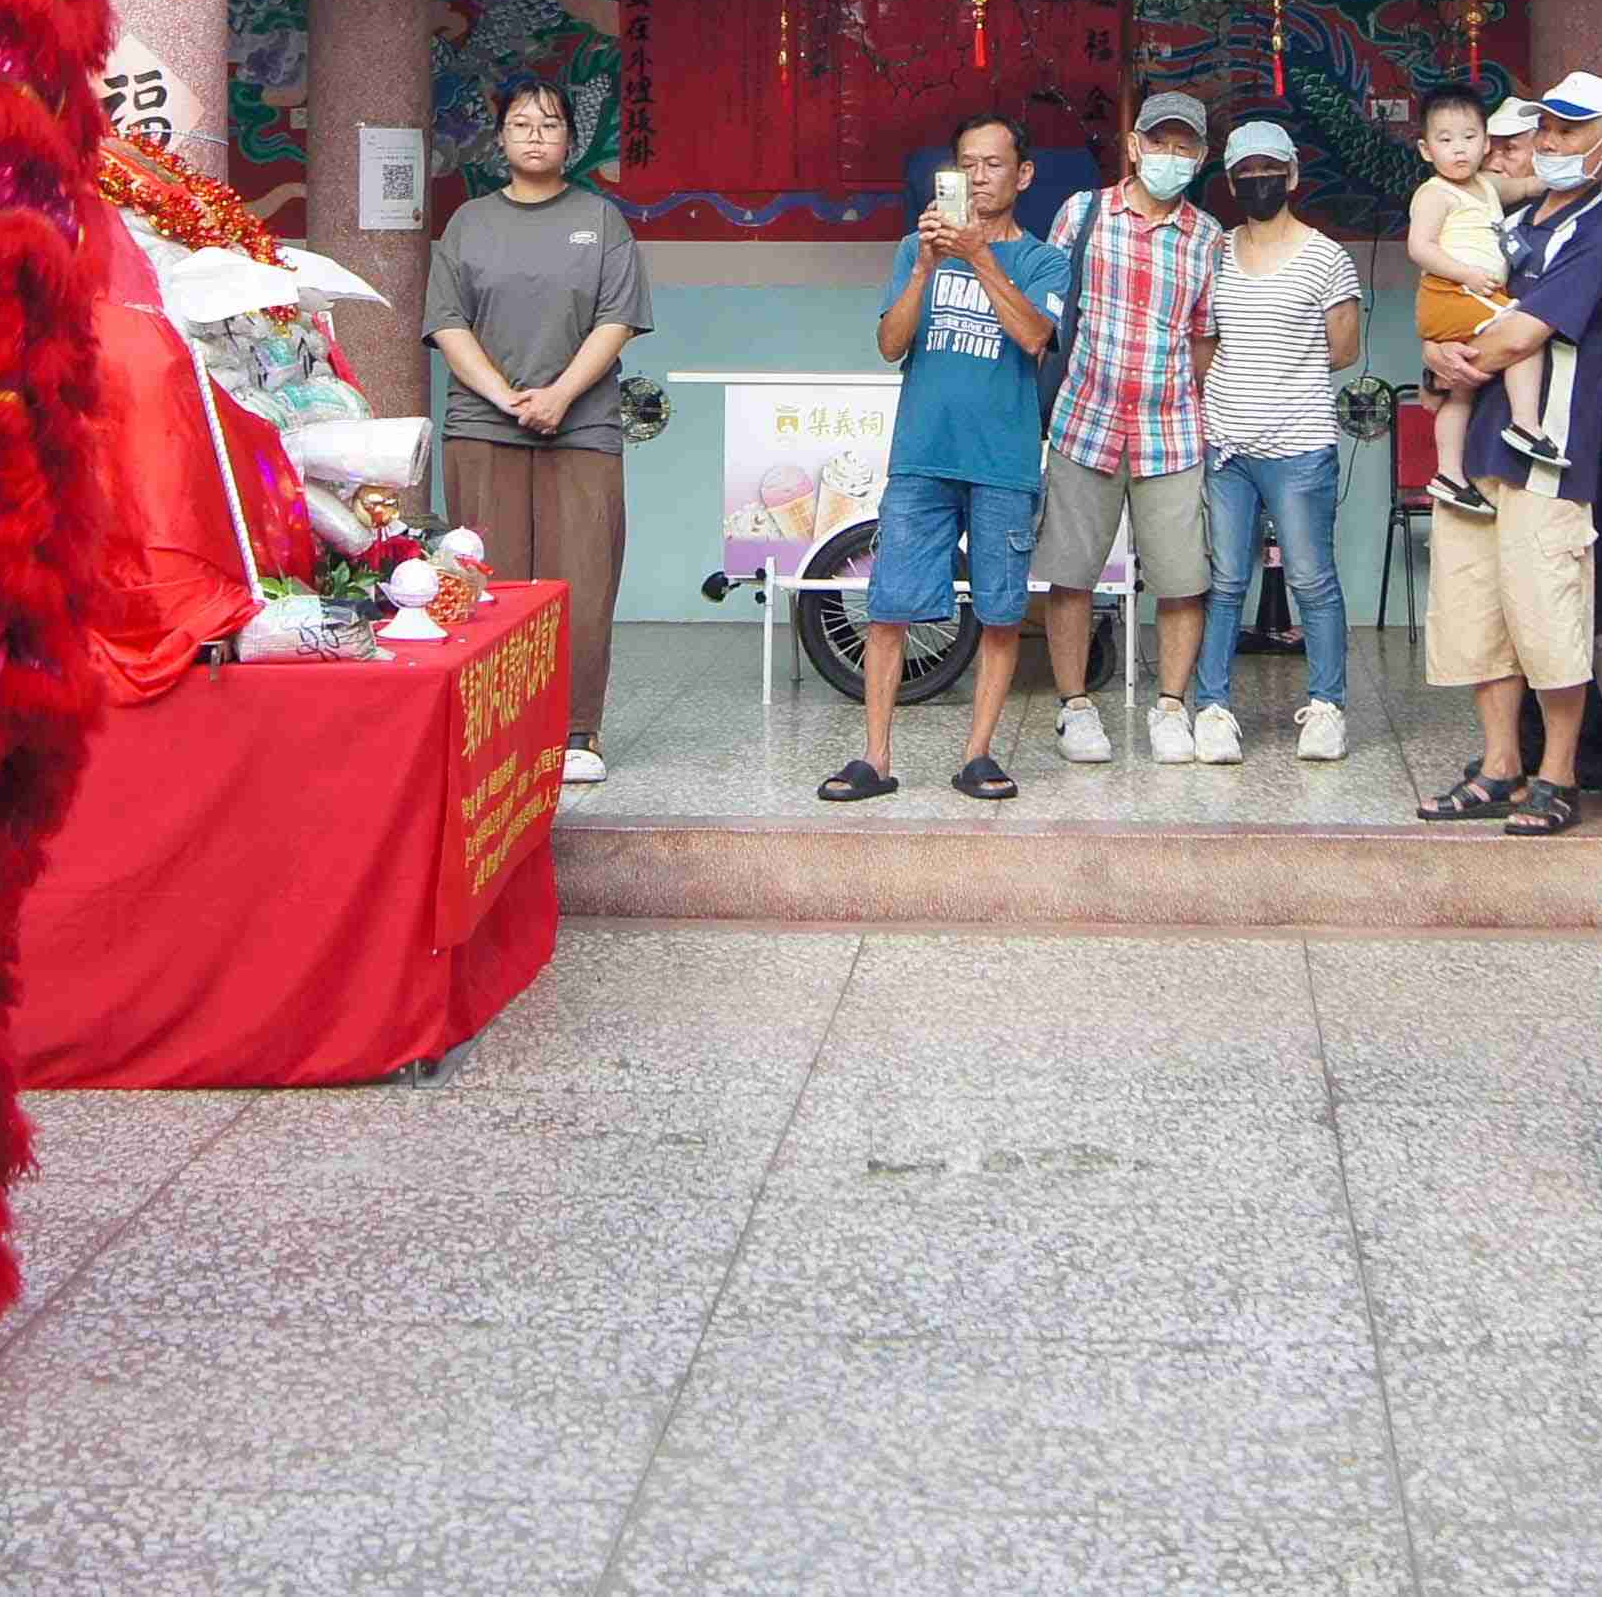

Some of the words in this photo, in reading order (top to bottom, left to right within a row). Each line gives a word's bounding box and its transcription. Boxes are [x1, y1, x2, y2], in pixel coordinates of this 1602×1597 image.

[103, 68, 172, 148] 福
[925, 330, 950, 352] STAY
[952, 332, 1001, 360] STRONG
